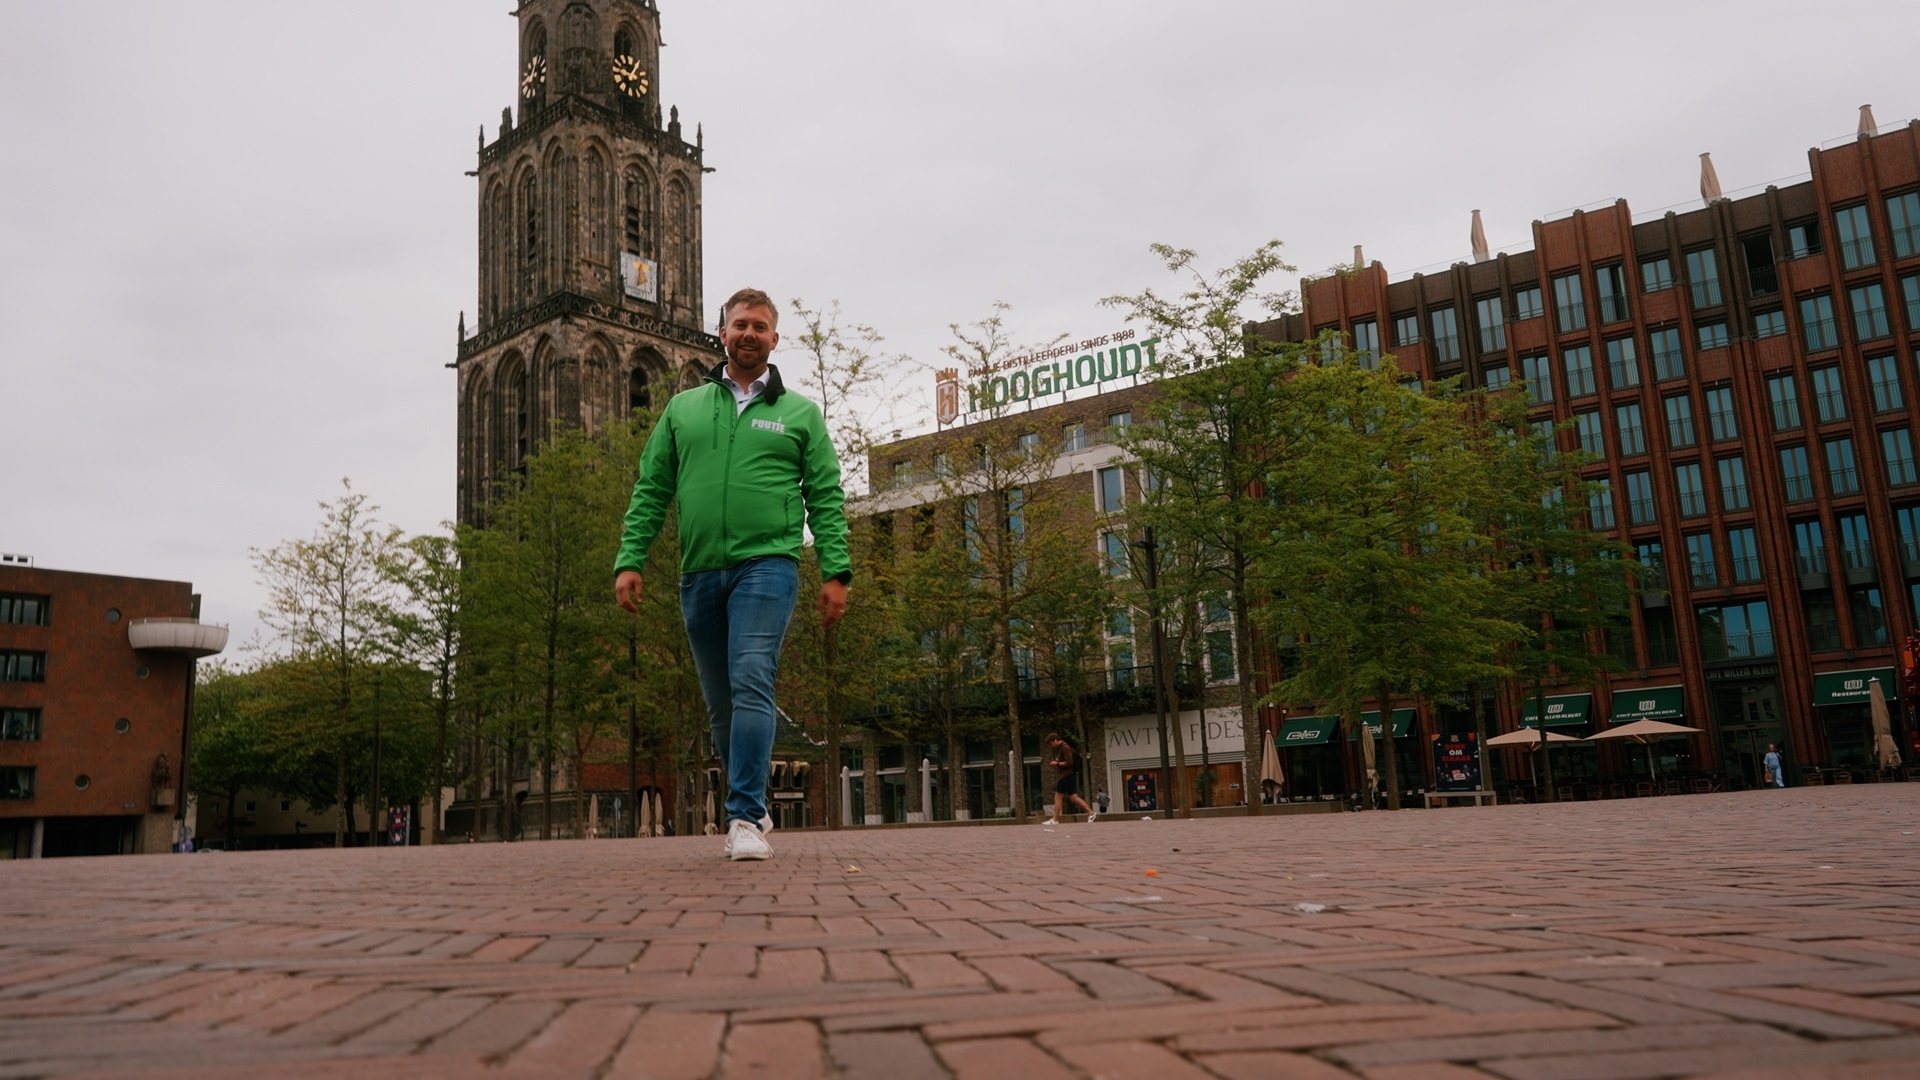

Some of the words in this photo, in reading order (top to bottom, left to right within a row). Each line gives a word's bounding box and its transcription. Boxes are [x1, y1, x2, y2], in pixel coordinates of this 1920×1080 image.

[1080, 335, 1109, 351] SINDS
[1112, 329, 1135, 342] 1888
[967, 337, 1162, 413] HOOGHOUDT
[752, 417, 785, 433] PUUTJE
[1723, 667, 1751, 678] WILLEM
[1752, 664, 1778, 676] ALBERT
[1831, 690, 1872, 698] Restauran
[1189, 720, 1246, 741] FDES
